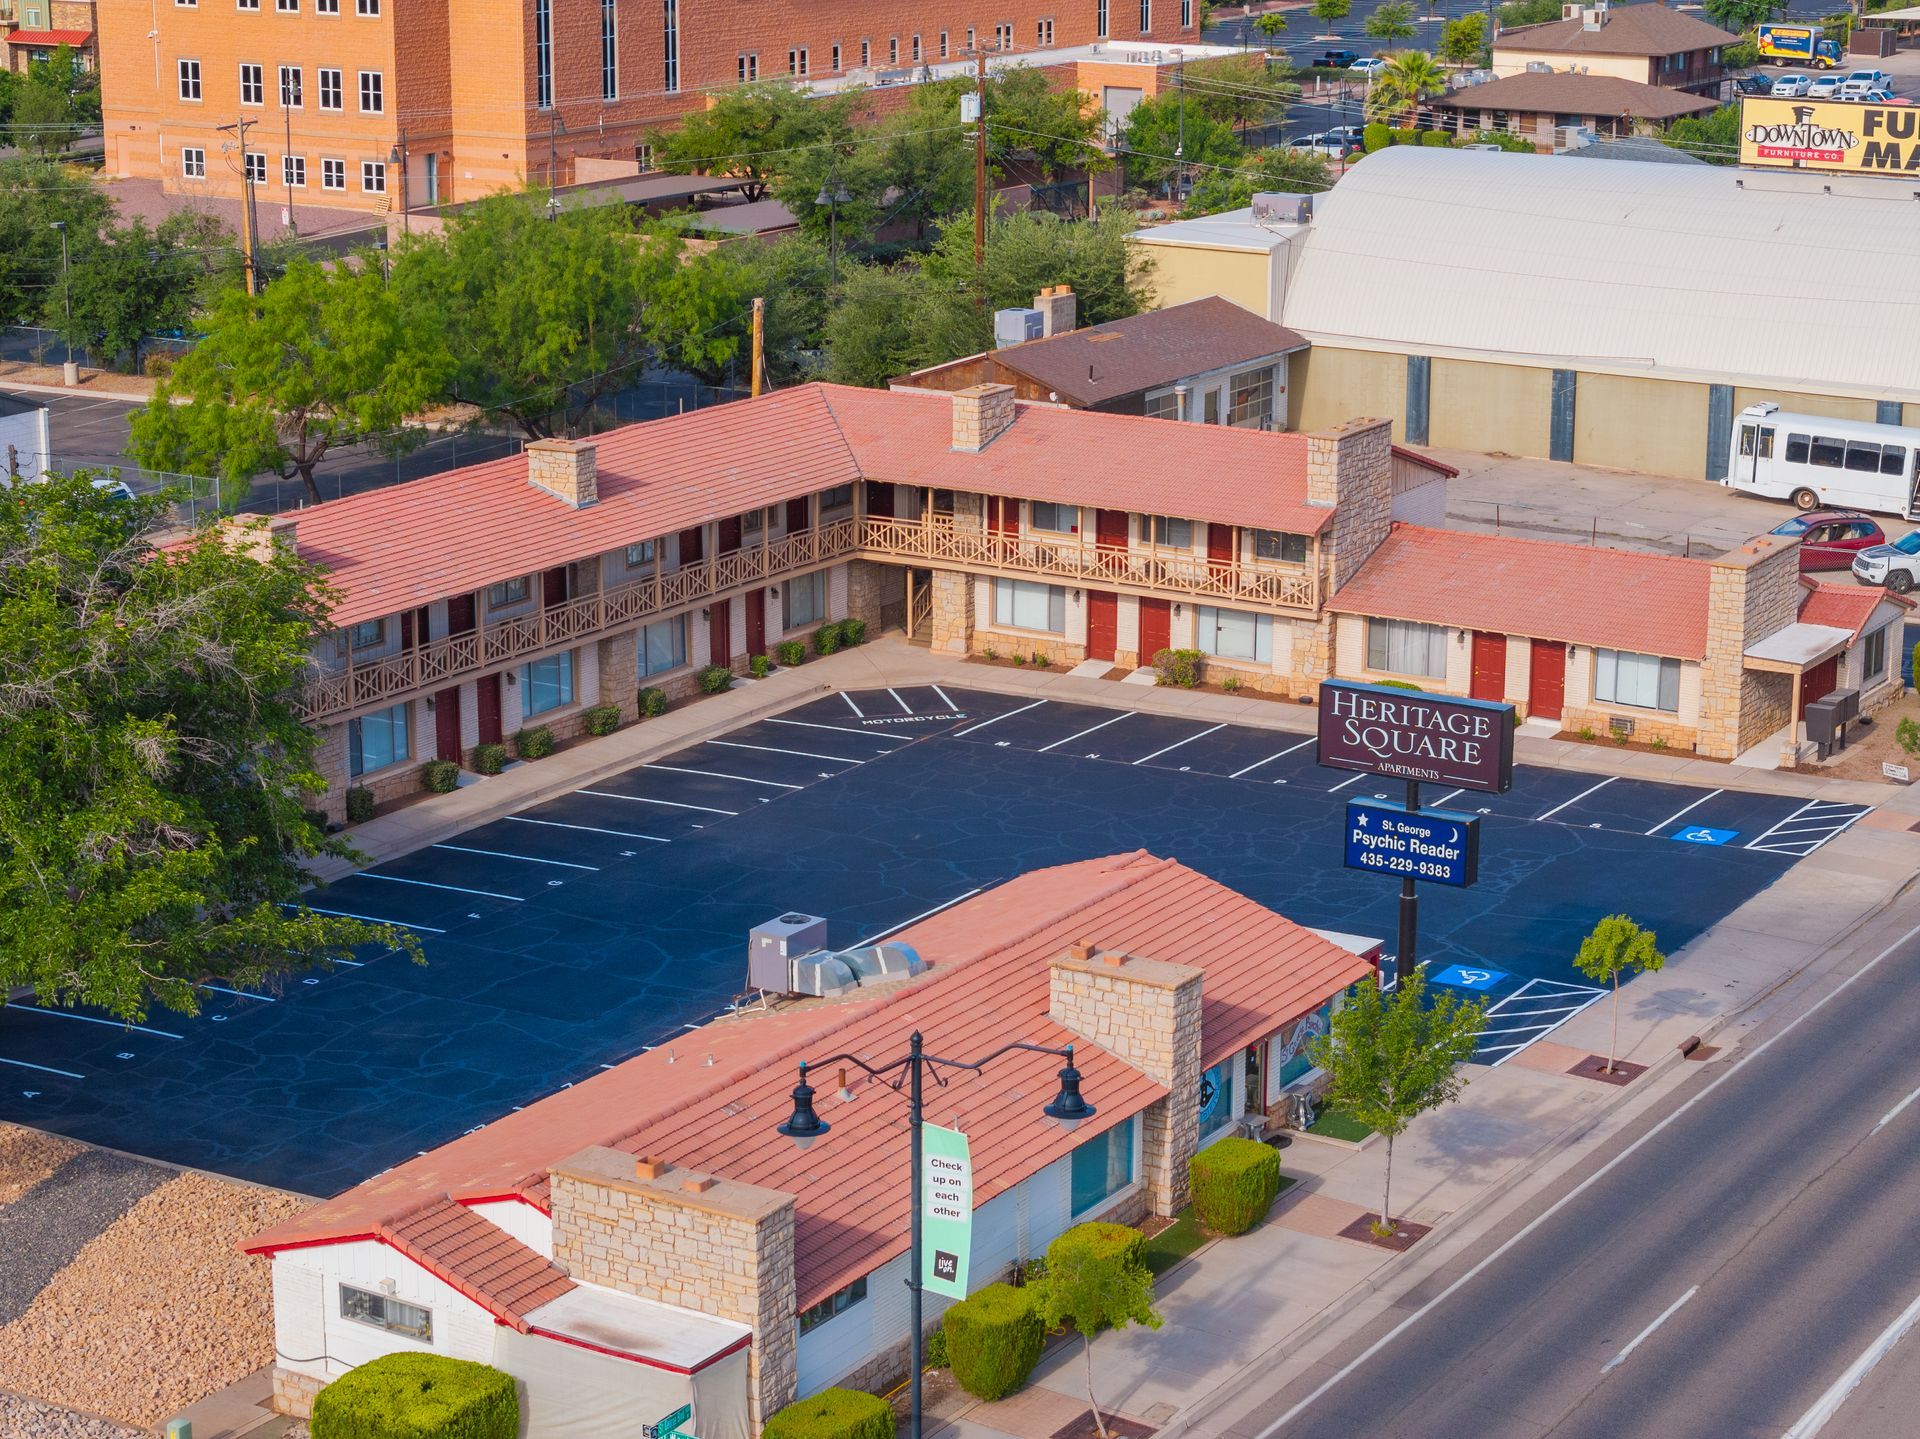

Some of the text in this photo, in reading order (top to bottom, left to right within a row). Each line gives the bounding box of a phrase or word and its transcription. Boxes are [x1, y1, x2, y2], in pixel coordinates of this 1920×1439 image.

[1862, 109, 1920, 140] FU
[1763, 148, 1840, 160] FURNITURE CO.
[862, 713, 968, 726] MOTORCYCLE
[1330, 690, 1491, 739] HERITAGE
[1342, 719, 1482, 766] SQUARE
[1377, 762, 1440, 780] APARTMENTS
[1382, 819, 1431, 838] St. George
[1352, 829, 1460, 861] Psychic Reader
[1359, 851, 1451, 879] 435-229-9383
[931, 1158, 963, 1172] Check
[932, 1176, 962, 1187] up on
[935, 1191, 960, 1202] each
[933, 1206, 961, 1218] other
